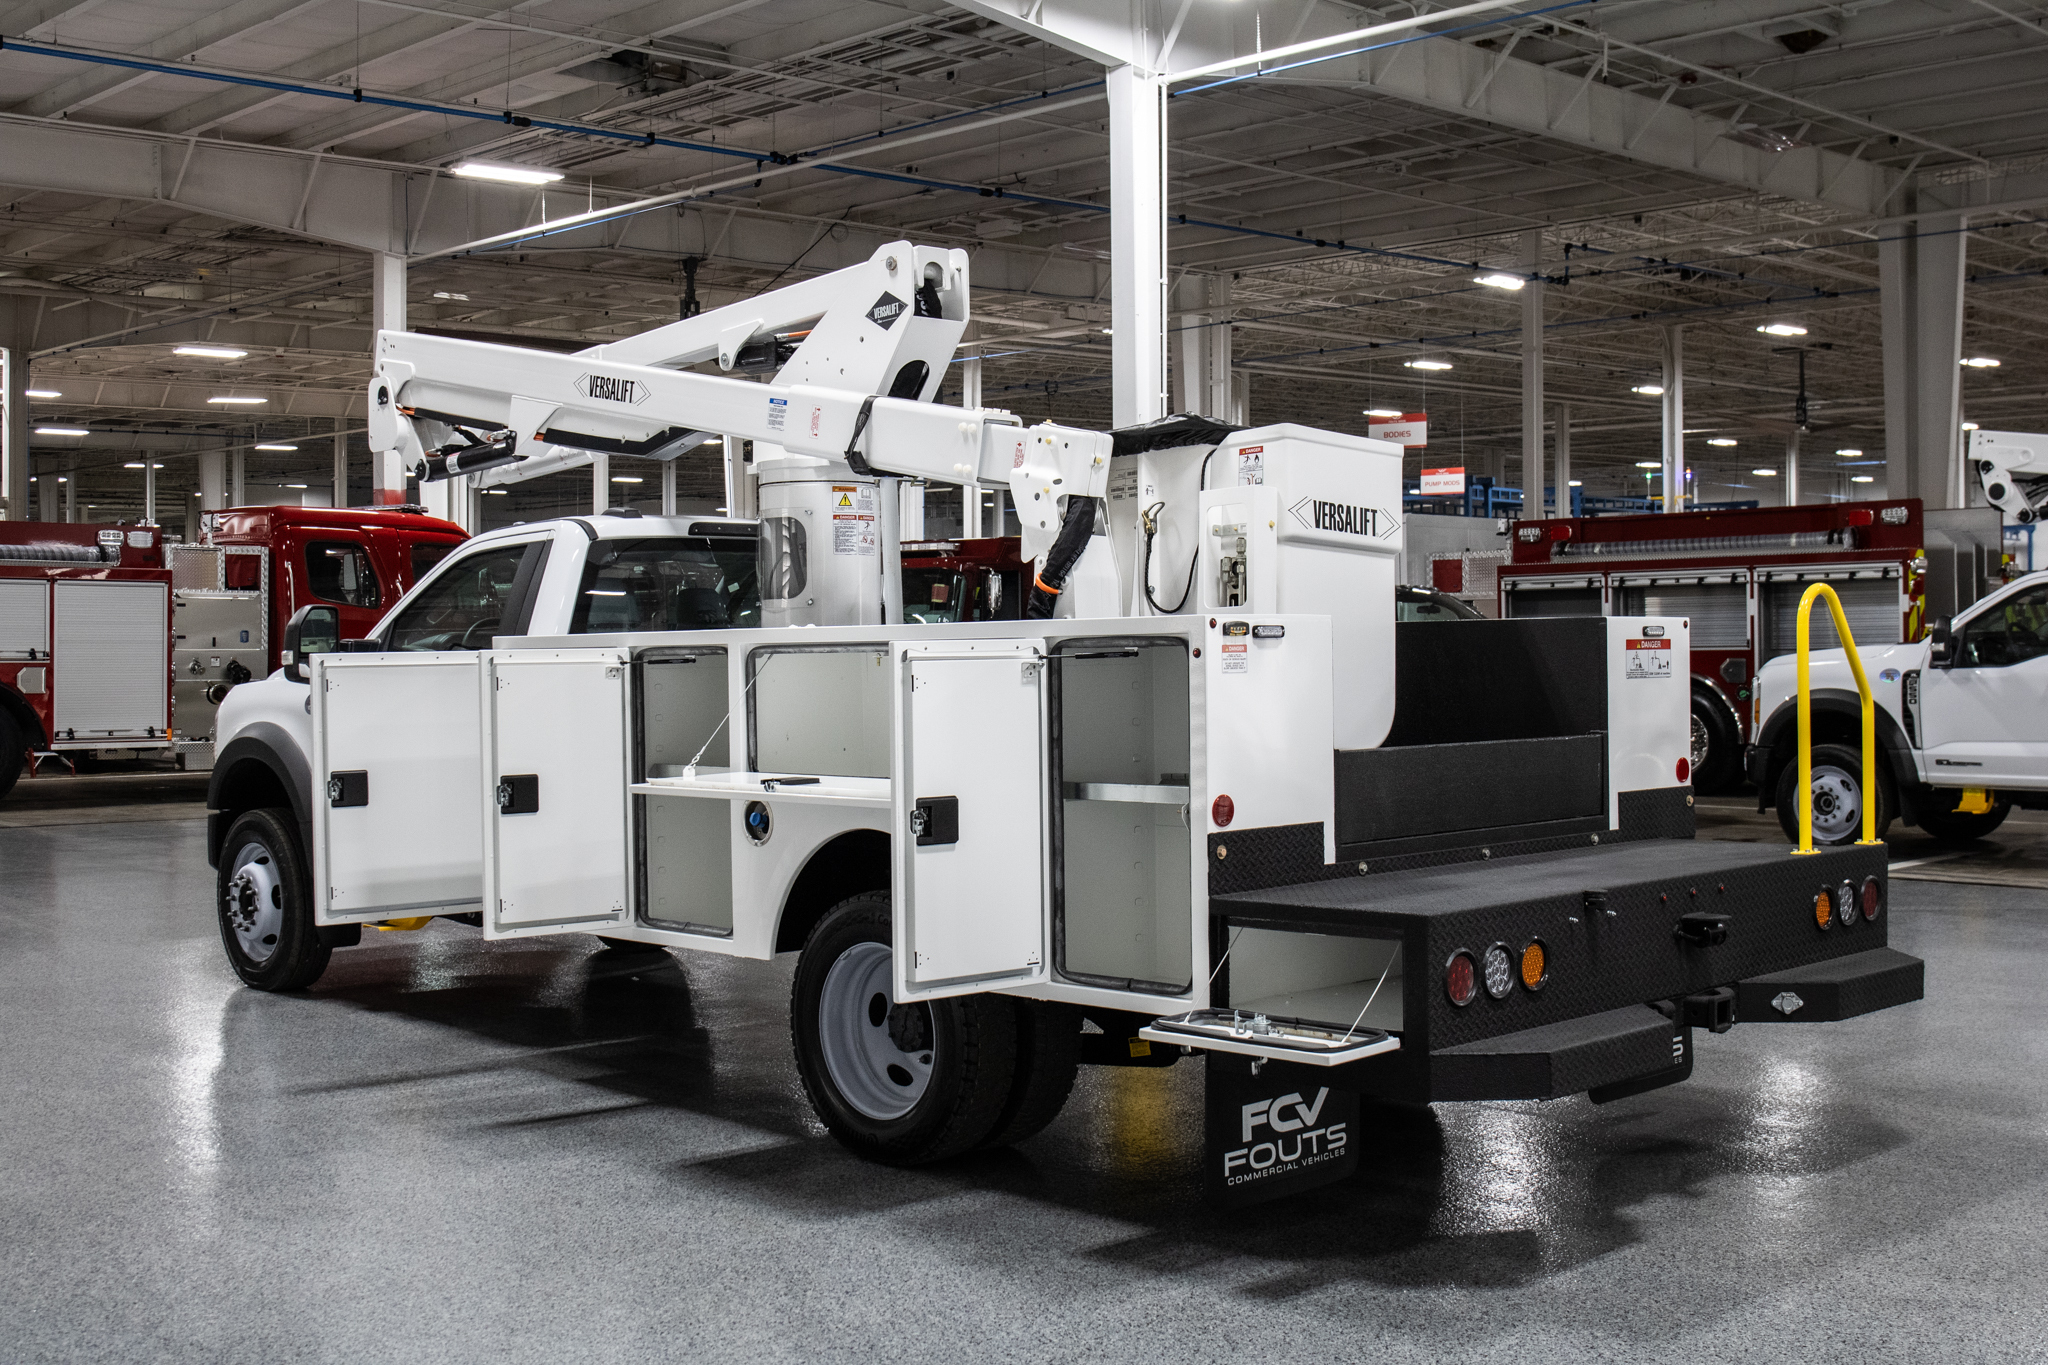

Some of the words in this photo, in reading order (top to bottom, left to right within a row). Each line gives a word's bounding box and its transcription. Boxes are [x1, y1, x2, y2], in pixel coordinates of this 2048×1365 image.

[873, 302, 899, 319] VERSALIFT
[589, 375, 635, 403] VERSALIFT
[1383, 430, 1411, 438] BODIES
[1313, 499, 1377, 536] VERSALIFT
[1641, 640, 1661, 648] DANGER
[1242, 1086, 1329, 1143] FCV
[1224, 1122, 1347, 1177] FOUTS
[1227, 1161, 1299, 1186] COMMERCIAL
[1301, 1147, 1345, 1167] VEHICLES
